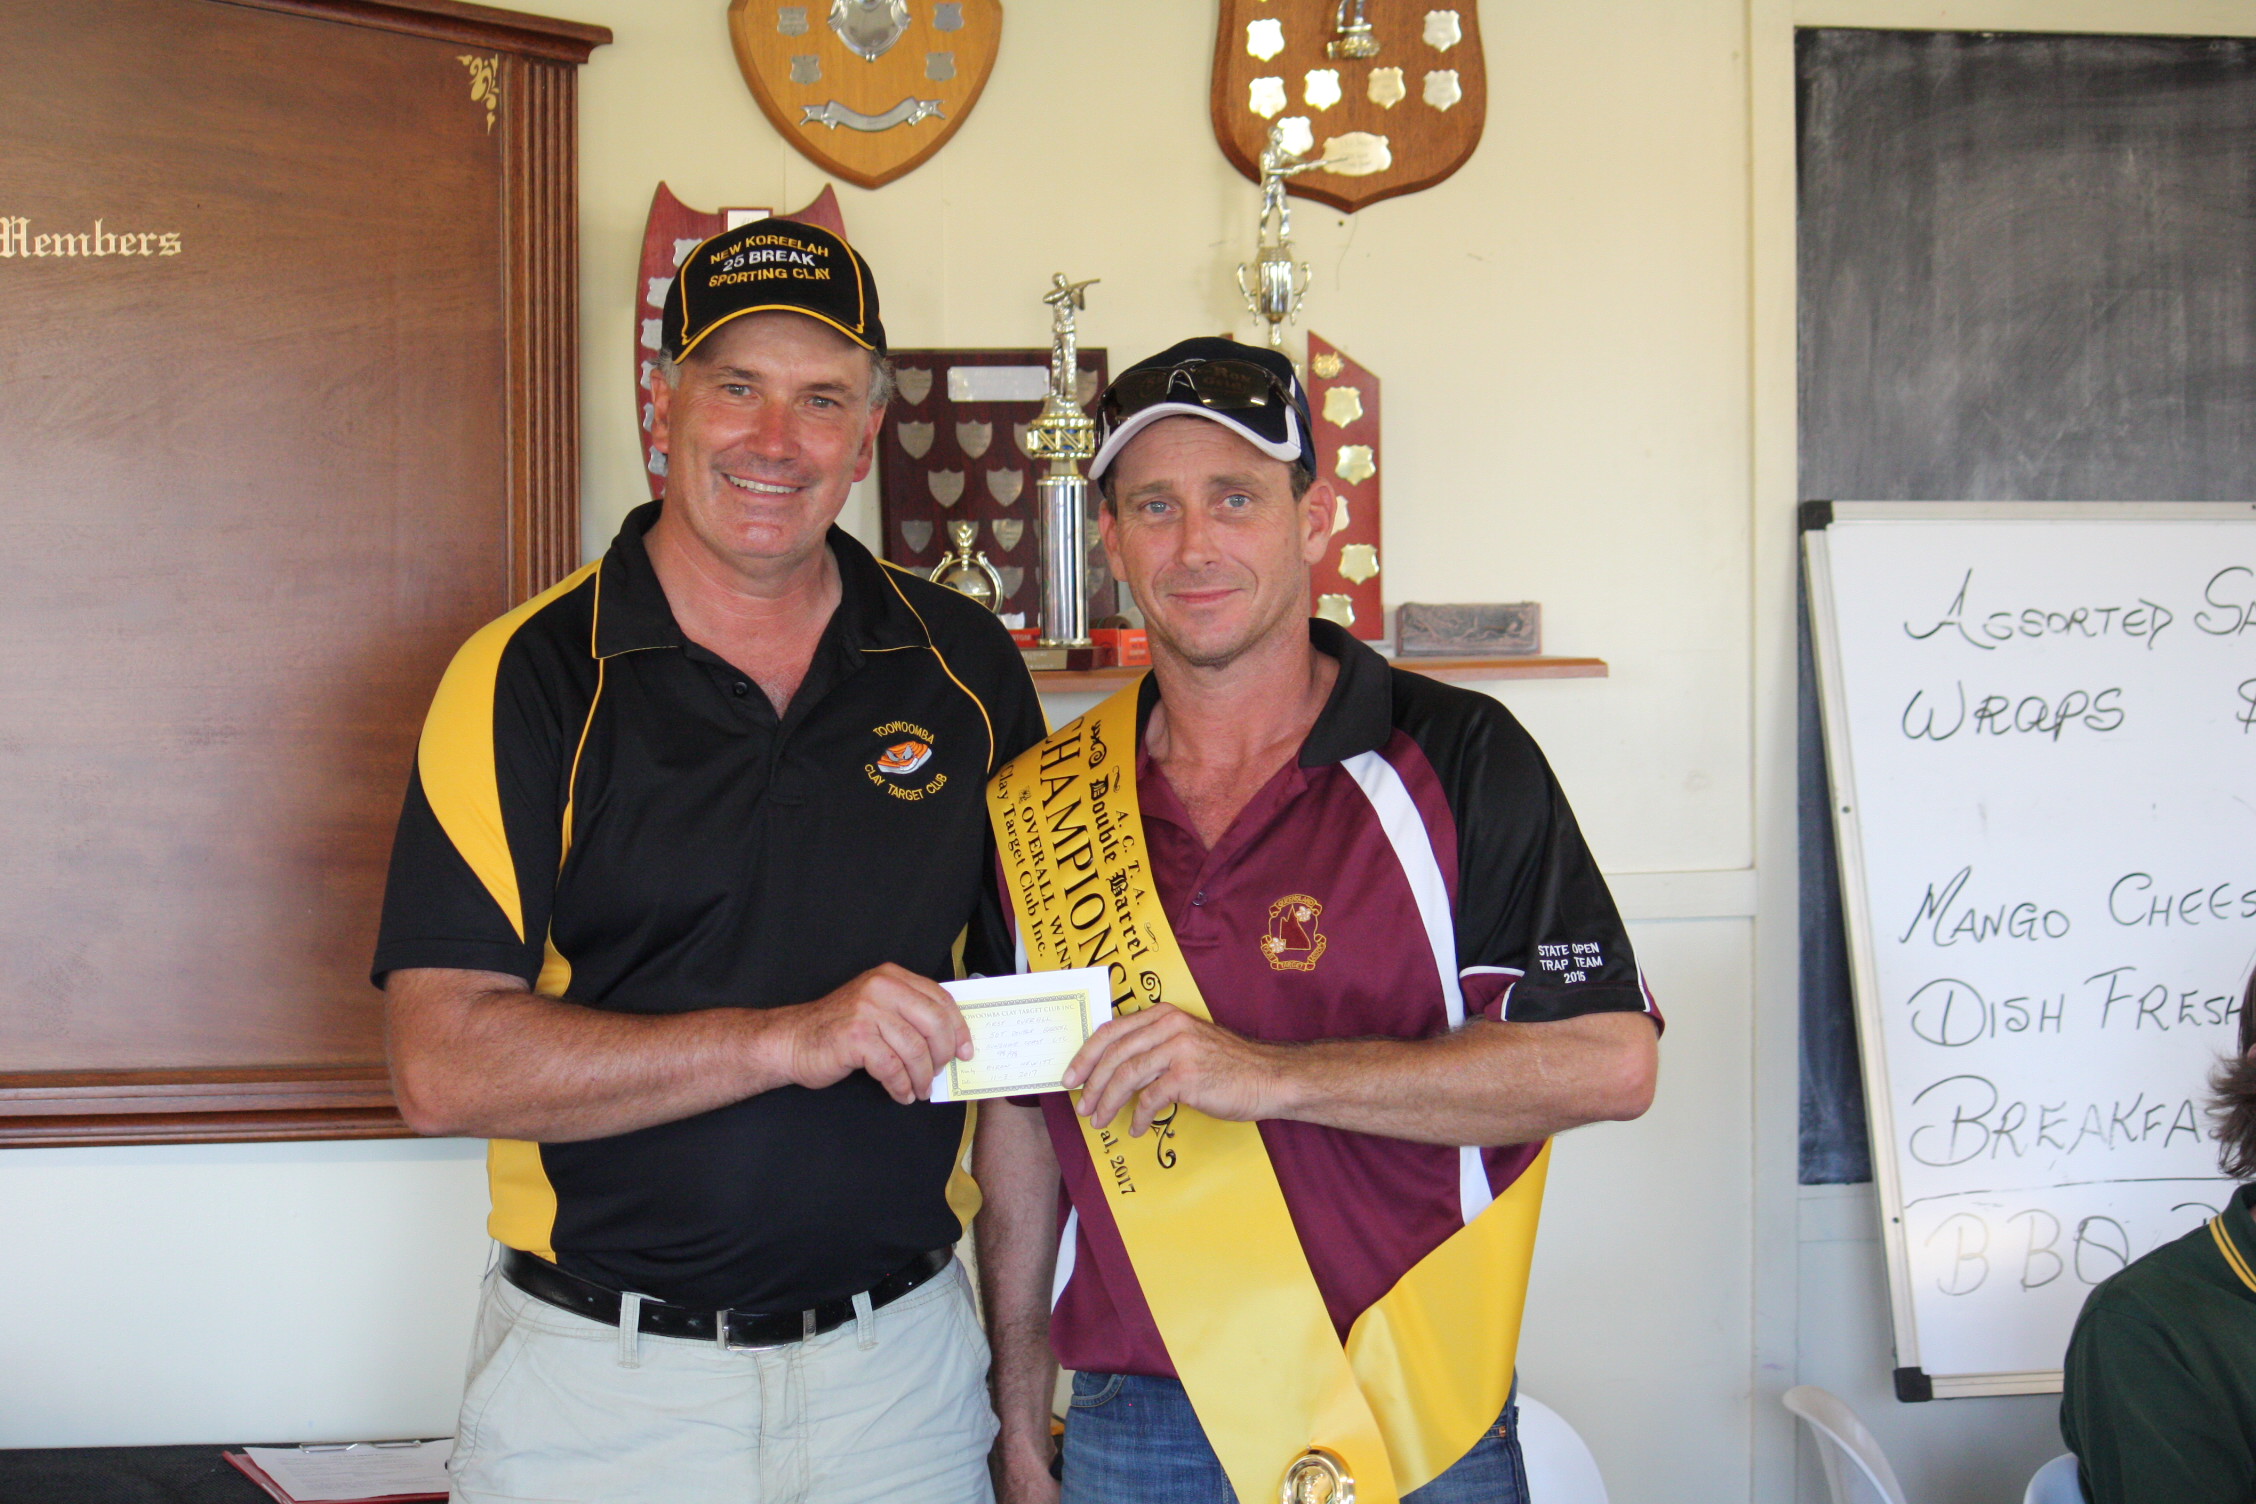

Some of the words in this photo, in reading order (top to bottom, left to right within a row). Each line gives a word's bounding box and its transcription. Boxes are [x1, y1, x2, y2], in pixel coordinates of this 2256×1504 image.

[0, 215, 182, 258] Members
[710, 241, 742, 265] NEW
[745, 234, 829, 258] KOREELAH
[708, 267, 788, 288] SPORTING
[792, 267, 831, 280] CLAY
[722, 251, 745, 272] 25
[748, 249, 816, 267] BREAK
[873, 720, 935, 745] TOOWOOMBA
[864, 763, 885, 786] CLAY
[887, 783, 924, 801] TARGET
[926, 773, 947, 794] CLUB
[1021, 806, 1056, 912] OVERALL
[1089, 774, 1118, 865] Double
[1106, 867, 1149, 962] Barrel
[1899, 866, 2070, 947] MANGO
[1537, 944, 1570, 957] STATE
[1571, 942, 1600, 954] OPEN
[1539, 959, 1568, 971] TRAP
[1573, 955, 1603, 968] TEAM
[1002, 804, 1027, 869] Target
[1019, 869, 1036, 917] Club
[1031, 918, 1046, 957] Inc.
[1110, 1155, 1136, 1195] 2017
[1907, 978, 2065, 1047] DISH
[1909, 1074, 2201, 1167] BREAKFA
